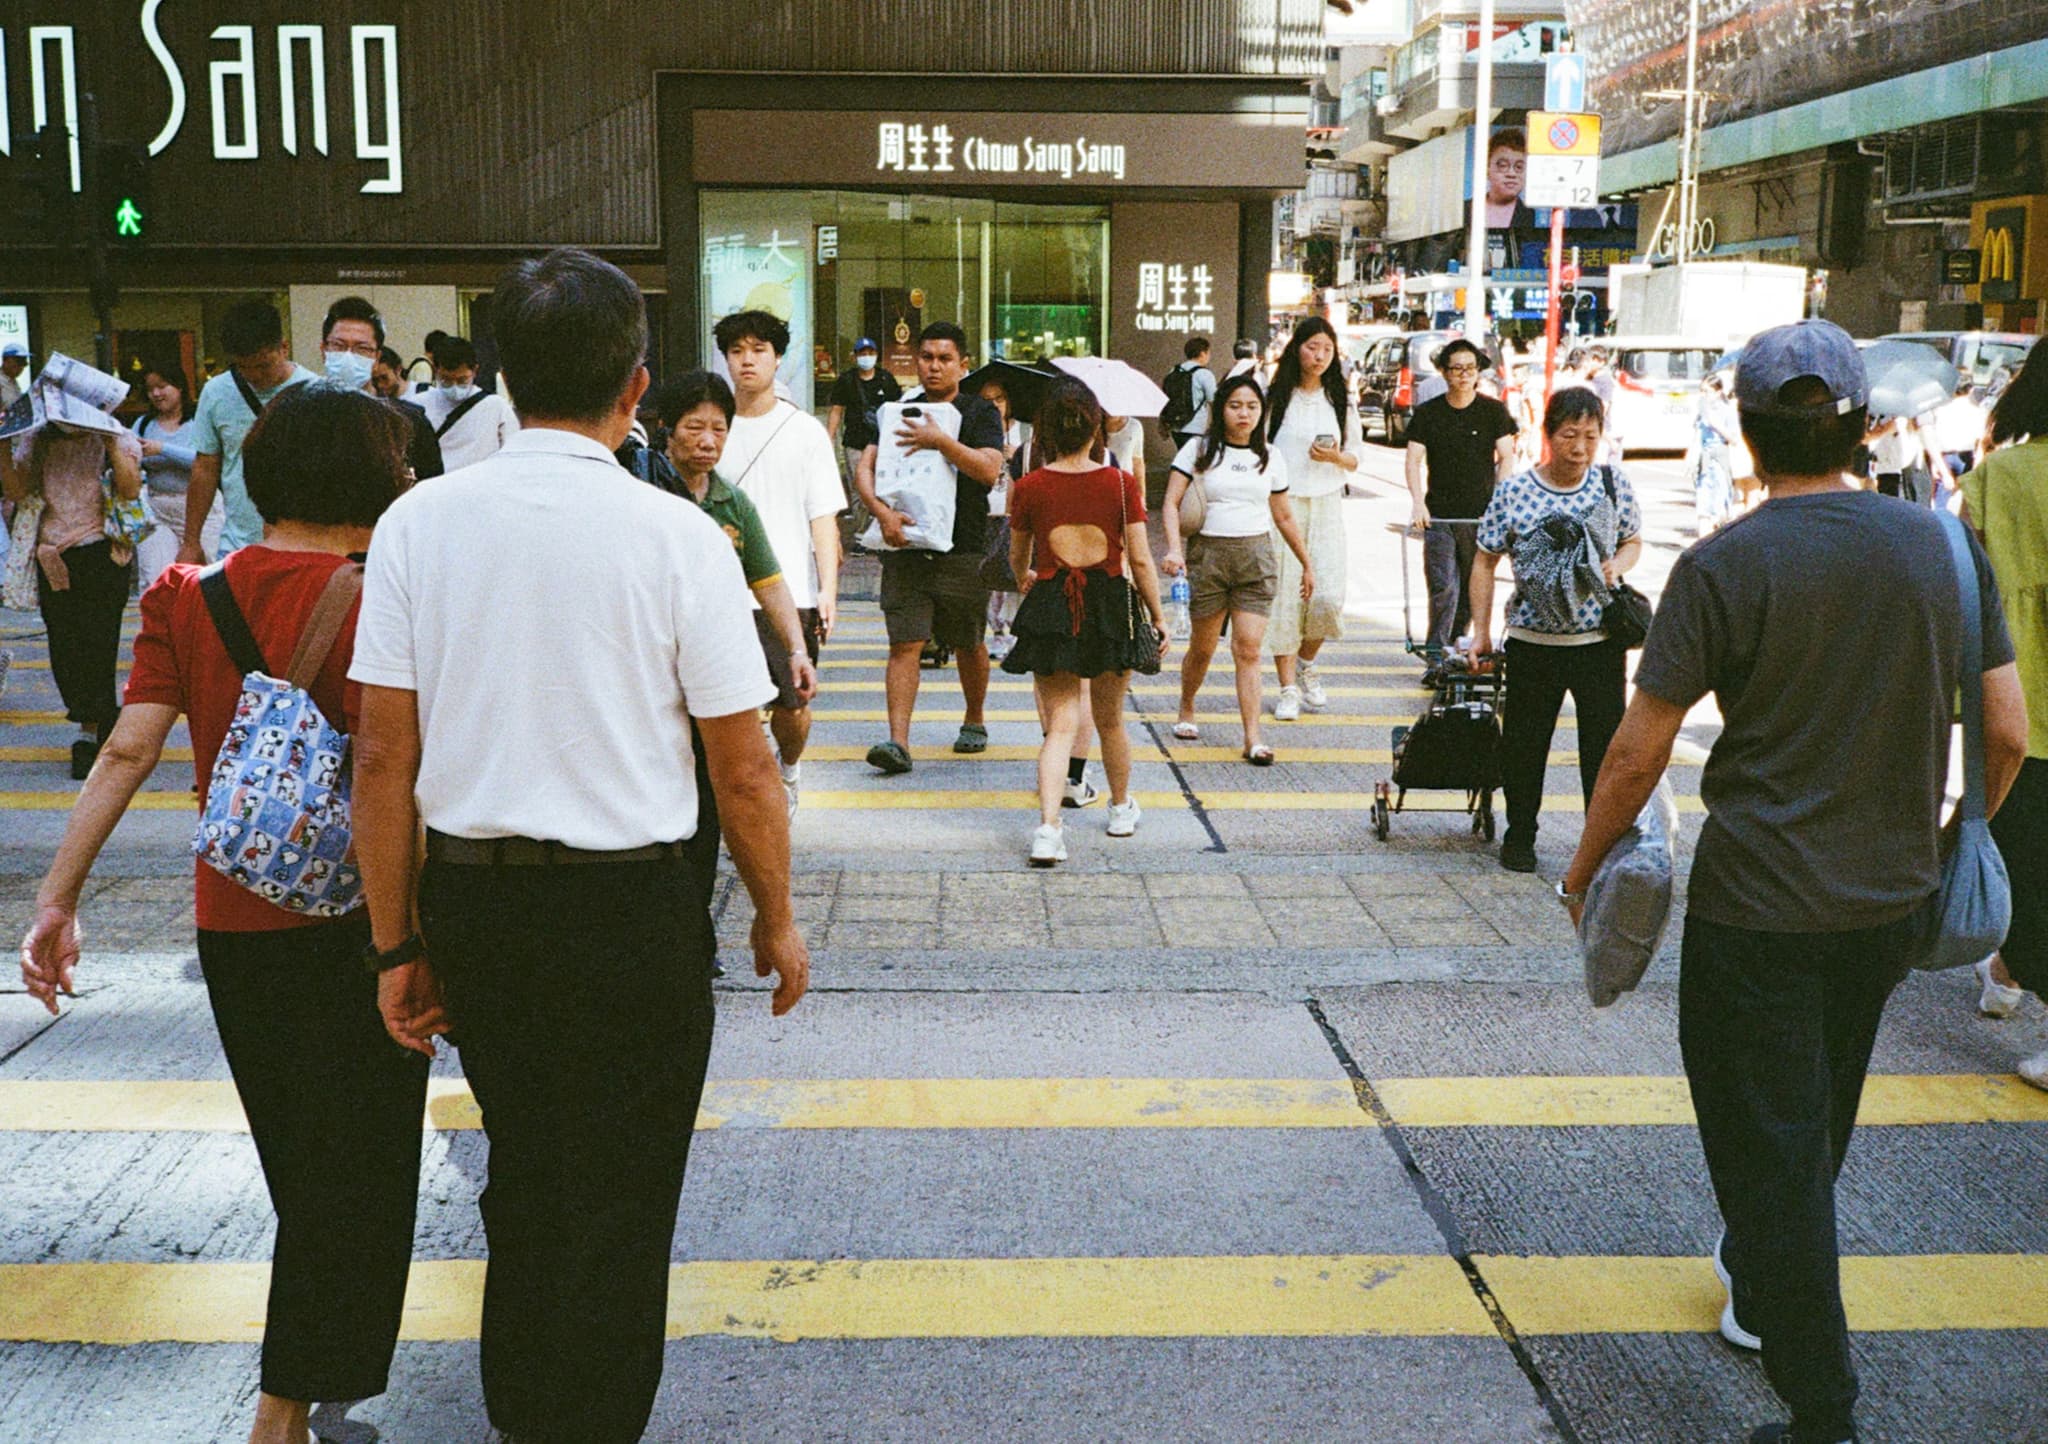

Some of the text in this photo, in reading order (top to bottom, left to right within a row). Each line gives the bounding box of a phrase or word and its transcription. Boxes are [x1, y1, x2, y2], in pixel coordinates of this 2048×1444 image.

[141, 0, 403, 194] Sang
[876, 122, 1126, 180] 周生生 Chow Sang Sang
[1573, 160, 1584, 175] 7
[1571, 187, 1592, 203] 12
[1135, 262, 1214, 311] 周生生
[1164, 312, 1188, 335] Sang
[1190, 312, 1214, 335] Sang
